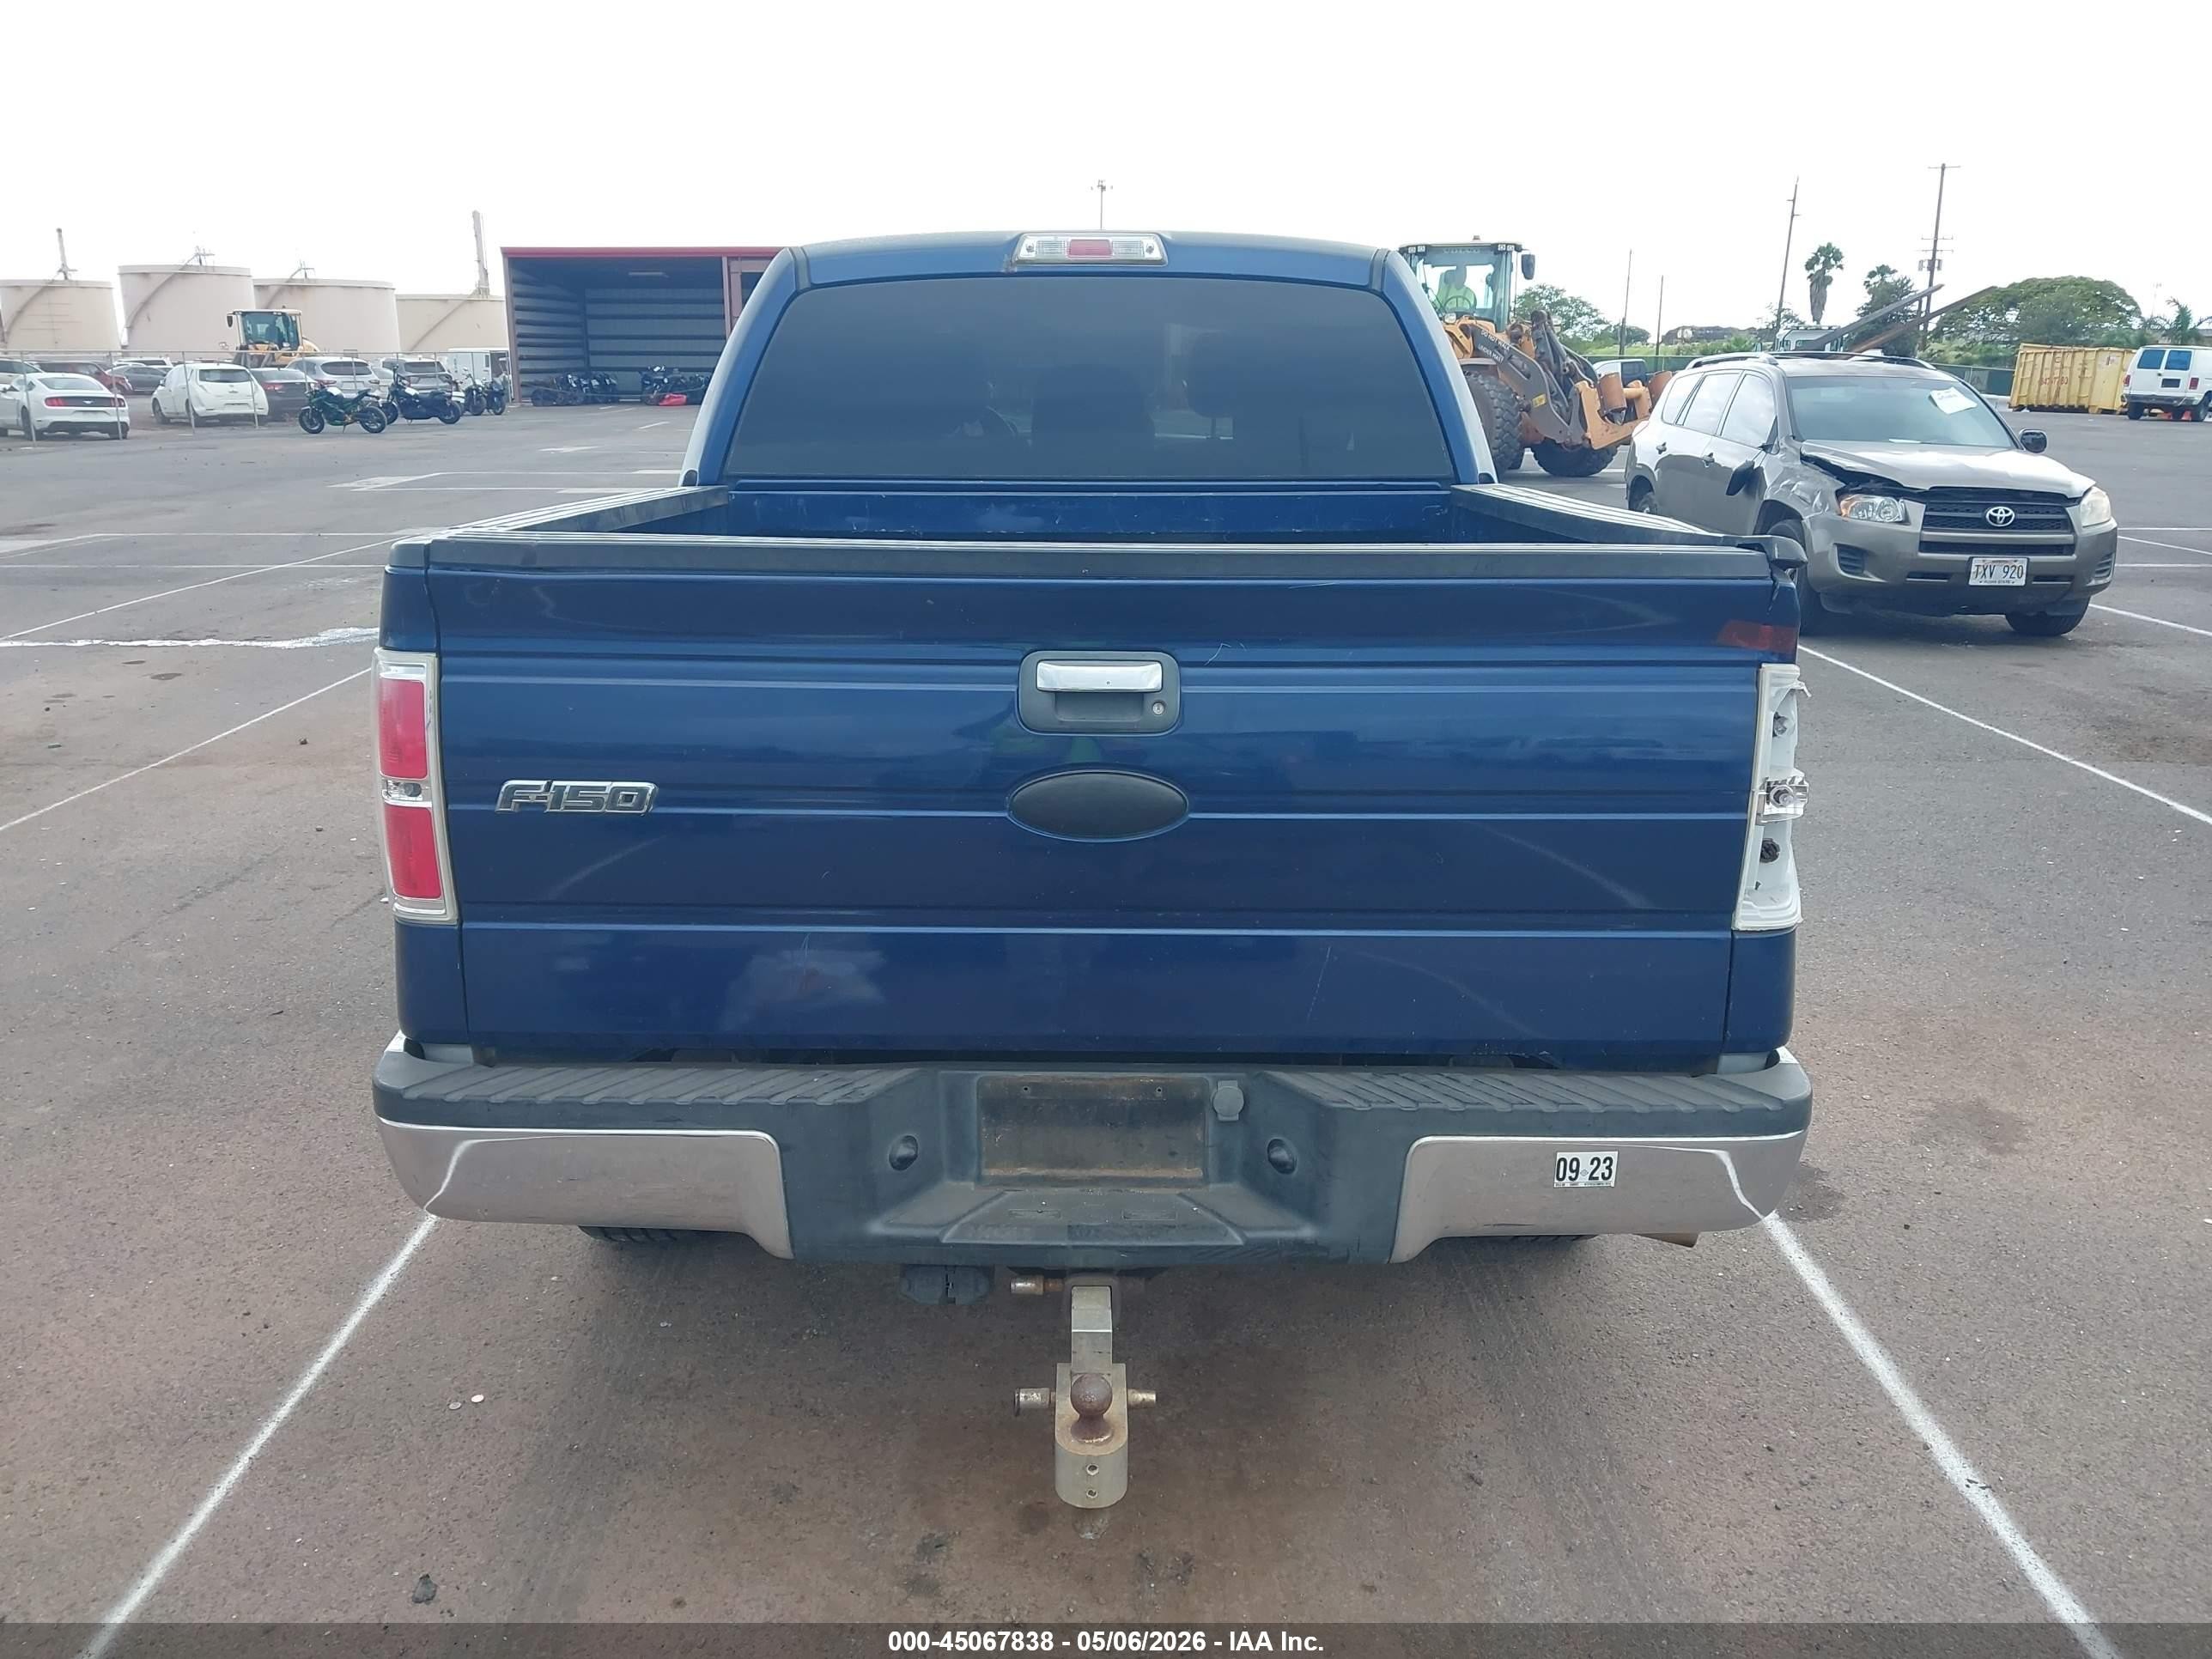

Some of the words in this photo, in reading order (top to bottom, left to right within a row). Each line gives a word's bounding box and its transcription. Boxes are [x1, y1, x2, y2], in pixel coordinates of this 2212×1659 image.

[1480, 329, 1489, 337] DO
[1975, 564, 1996, 579] TXV
[2002, 564, 2024, 579] 920
[495, 780, 659, 816] F-150
[1556, 1157, 1580, 1182] 09
[1588, 1156, 1613, 1181] 23
